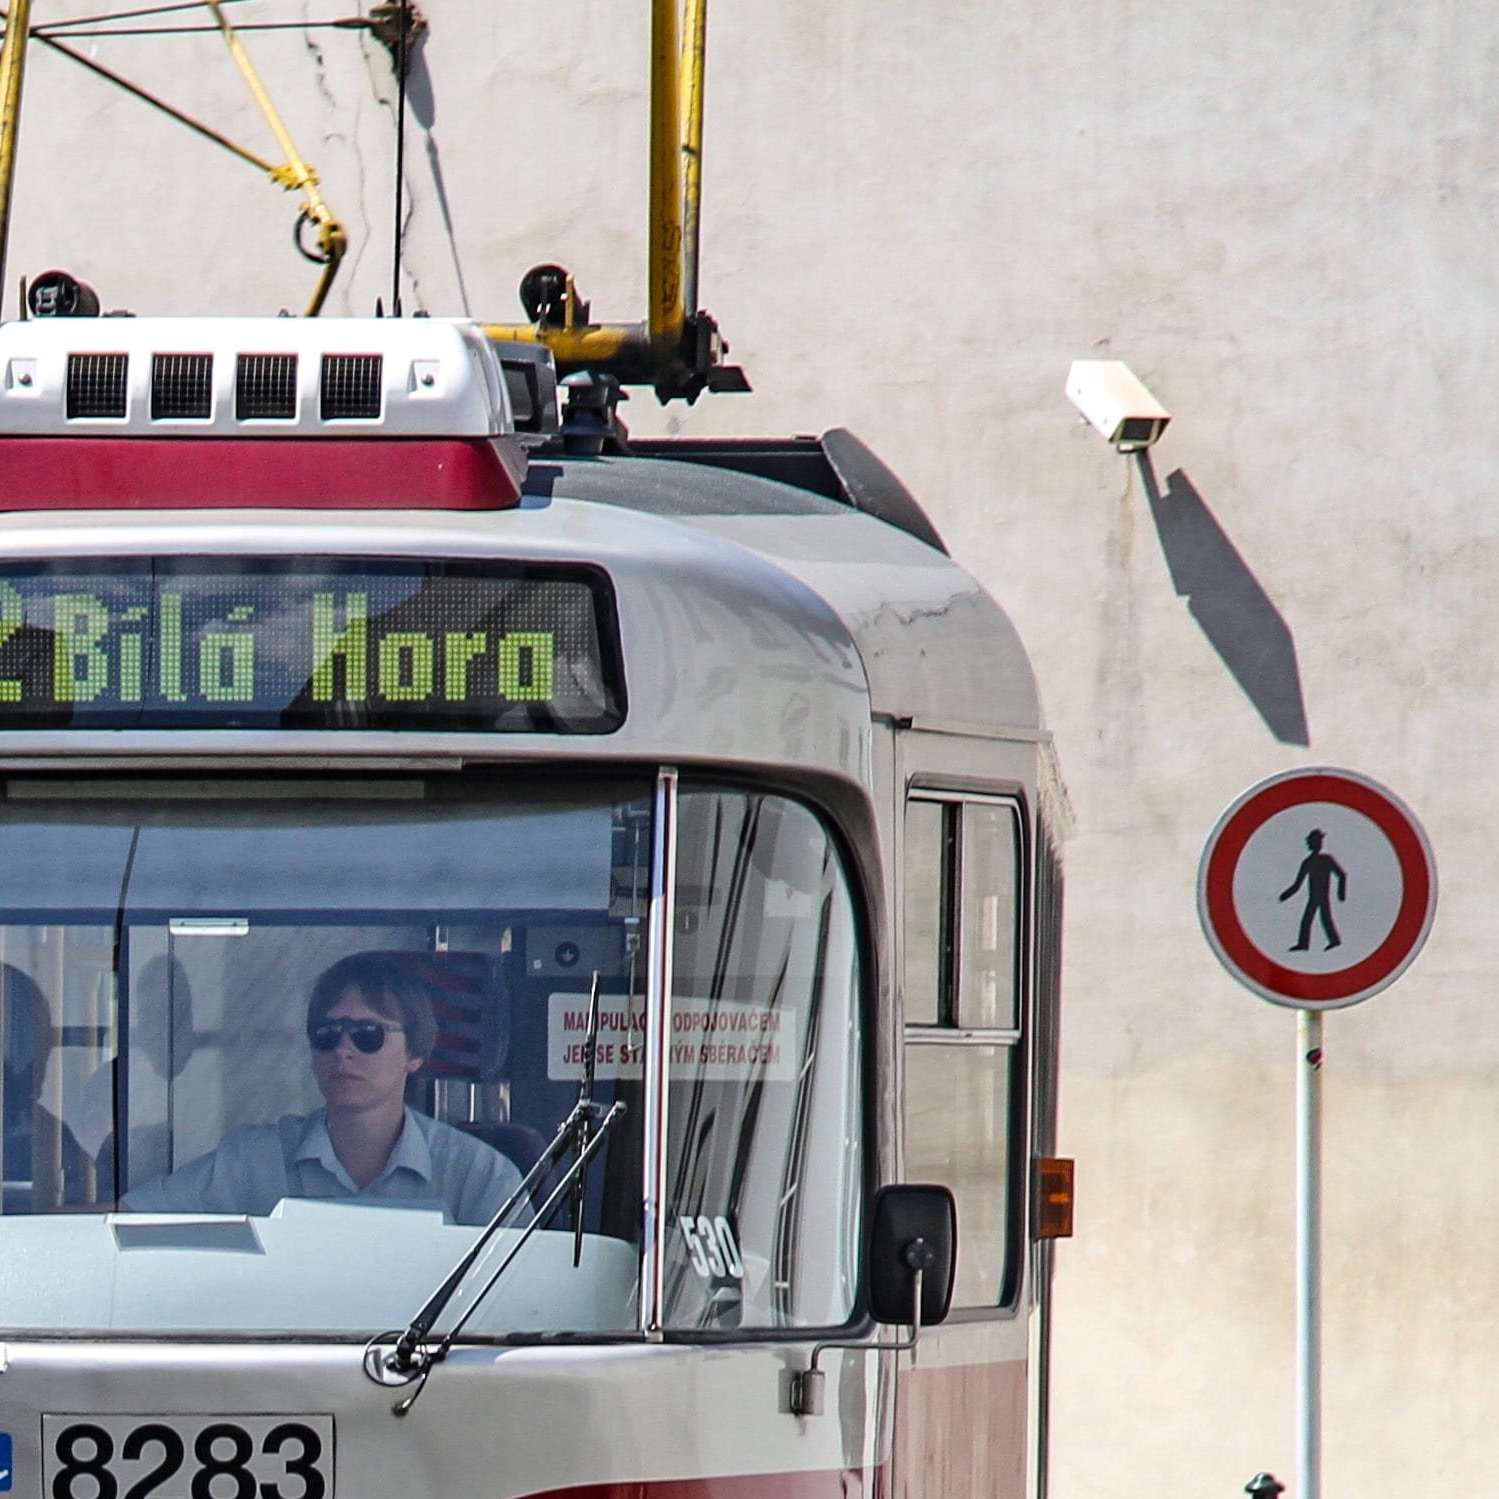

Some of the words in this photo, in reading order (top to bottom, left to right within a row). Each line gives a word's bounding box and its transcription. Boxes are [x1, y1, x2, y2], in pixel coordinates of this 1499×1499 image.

[53, 592, 254, 702] Bílá
[312, 592, 554, 702] Hora
[596, 1043, 614, 1065] SE
[679, 1215, 744, 1278] 530
